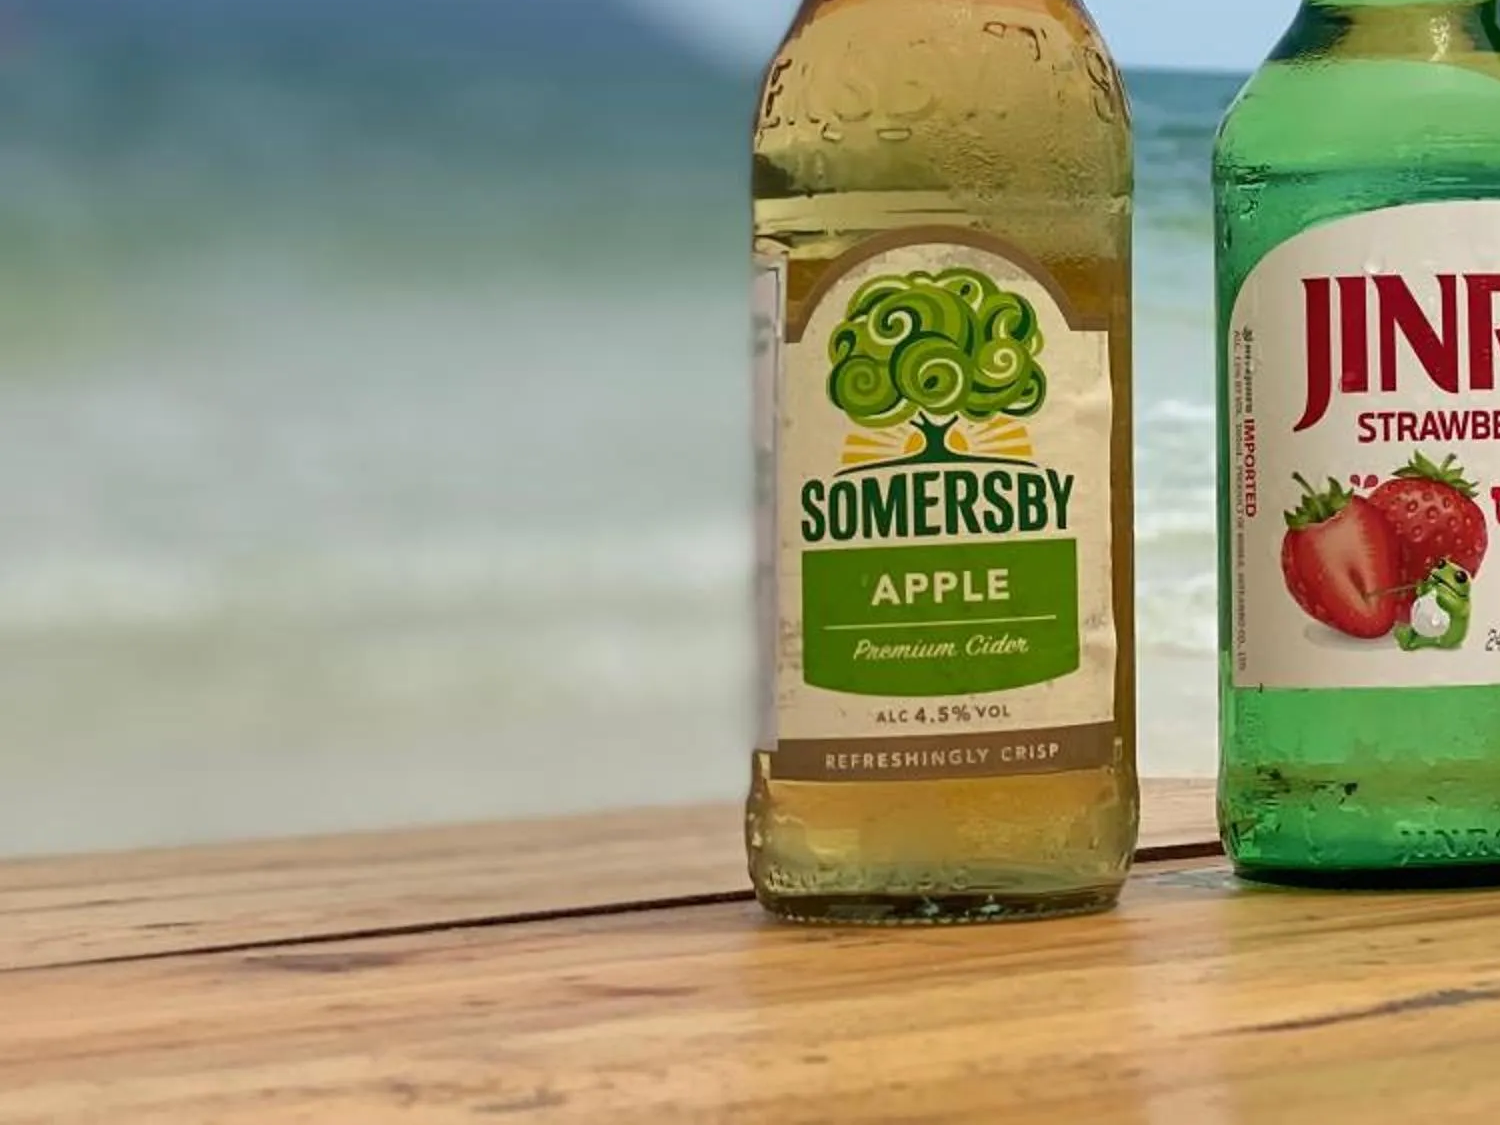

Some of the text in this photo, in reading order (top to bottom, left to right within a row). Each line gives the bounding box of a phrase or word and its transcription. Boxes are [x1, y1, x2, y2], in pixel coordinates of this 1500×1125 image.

[1243, 418, 1257, 518] IMPORTED
[801, 468, 1075, 543] SOMERSBY
[871, 568, 1011, 607] APPLE
[853, 633, 1029, 660] Premium Cider
[876, 704, 1011, 725] ALC 4.5% VOL
[825, 742, 1060, 771] REFRESHINGLY CRISP
